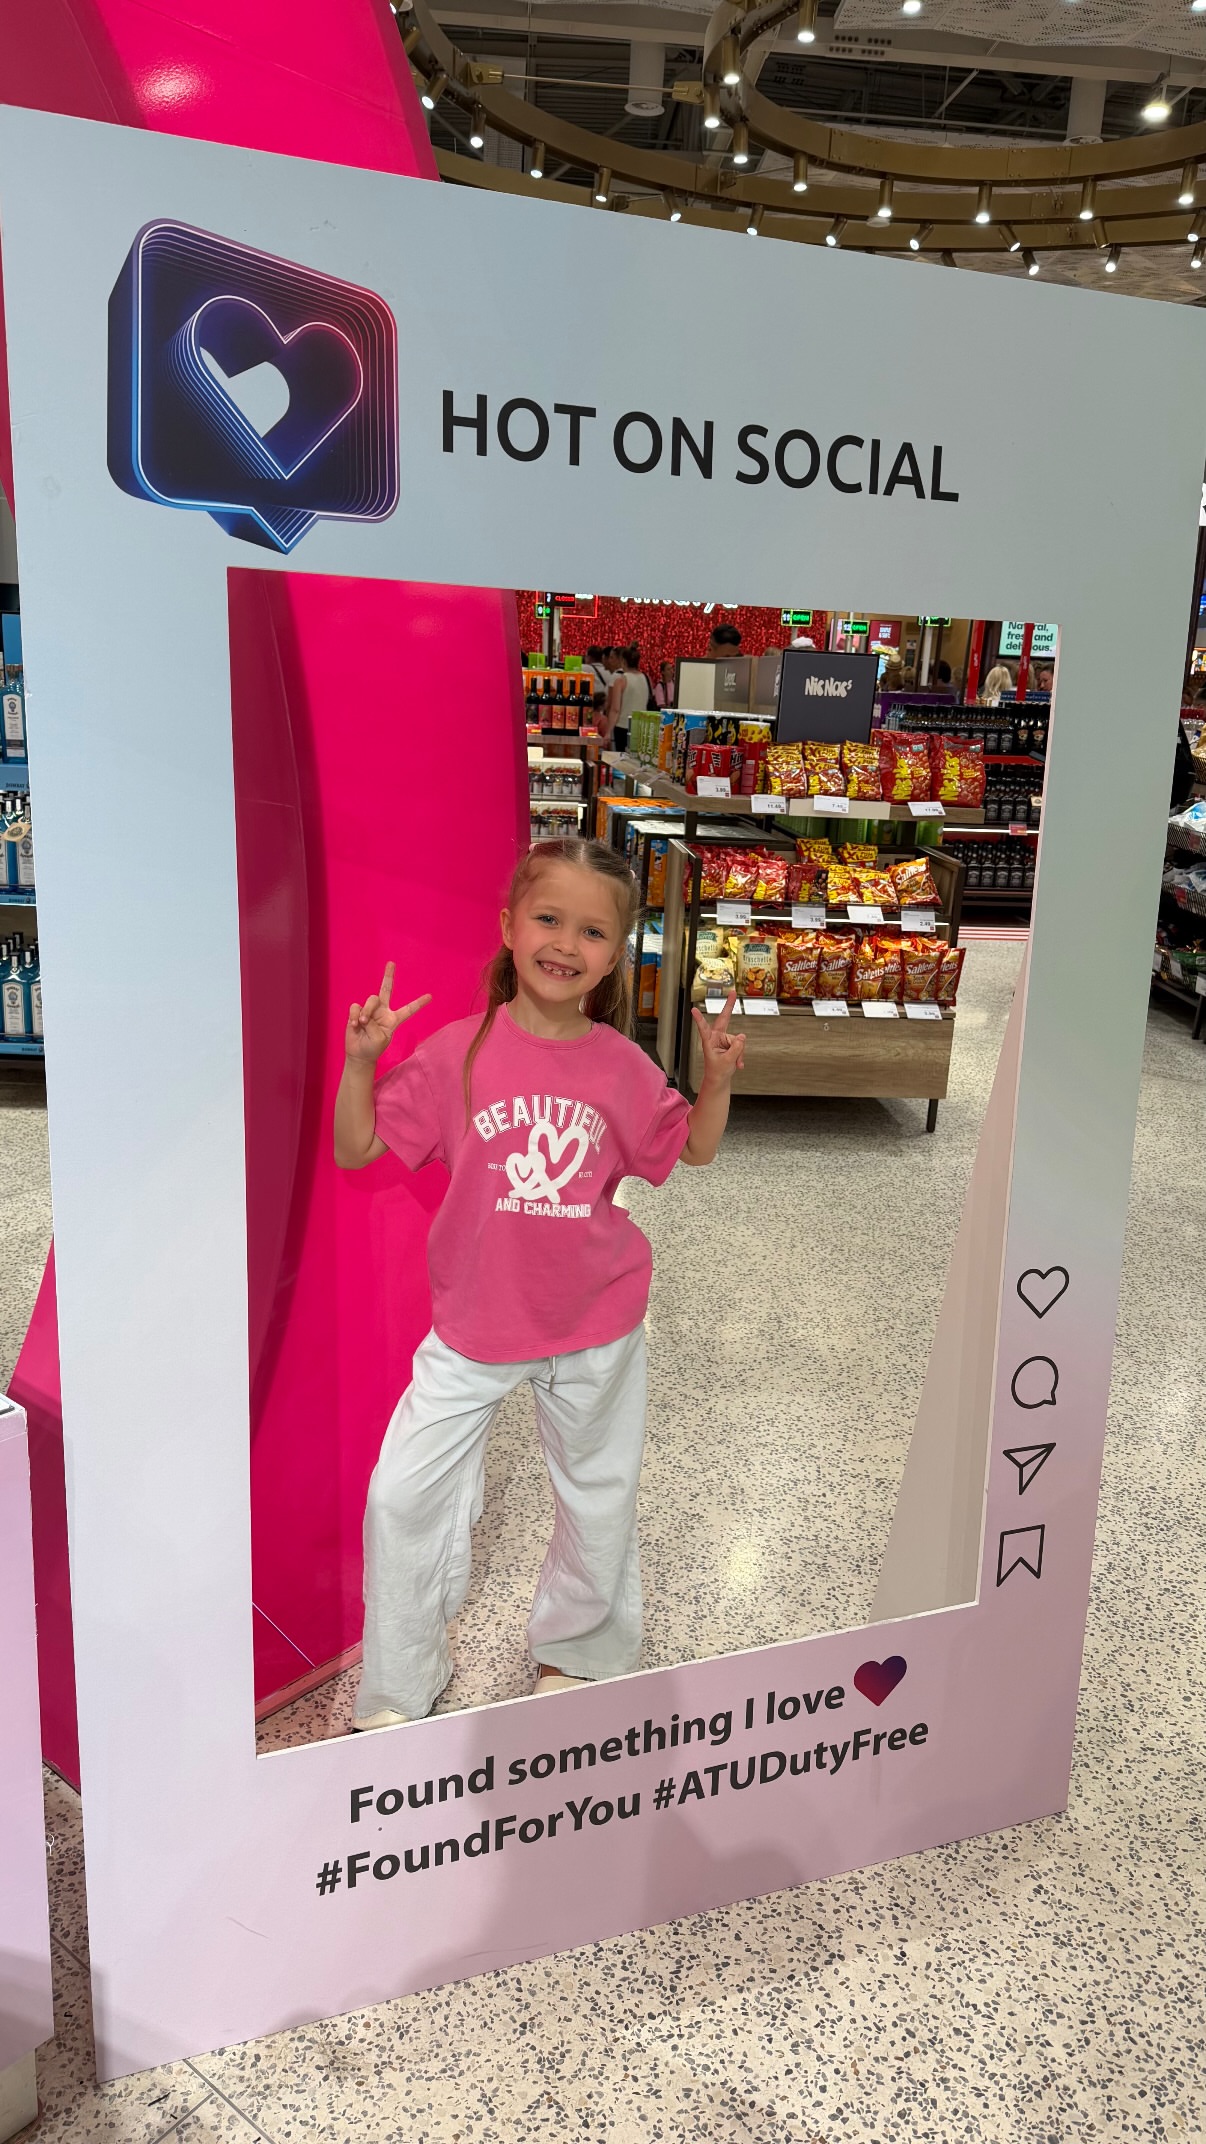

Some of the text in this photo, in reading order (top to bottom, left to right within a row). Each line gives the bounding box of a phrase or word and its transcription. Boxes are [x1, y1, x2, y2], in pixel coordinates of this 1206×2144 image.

[442, 389, 960, 502] HOT ON SOCIAL
[1034, 633, 1054, 642] and
[495, 1197, 592, 1219] AND CHARMING
[315, 1722, 929, 1896] #FoundForYou #ATUDutyFree
[349, 1686, 845, 1823] Found something I love
